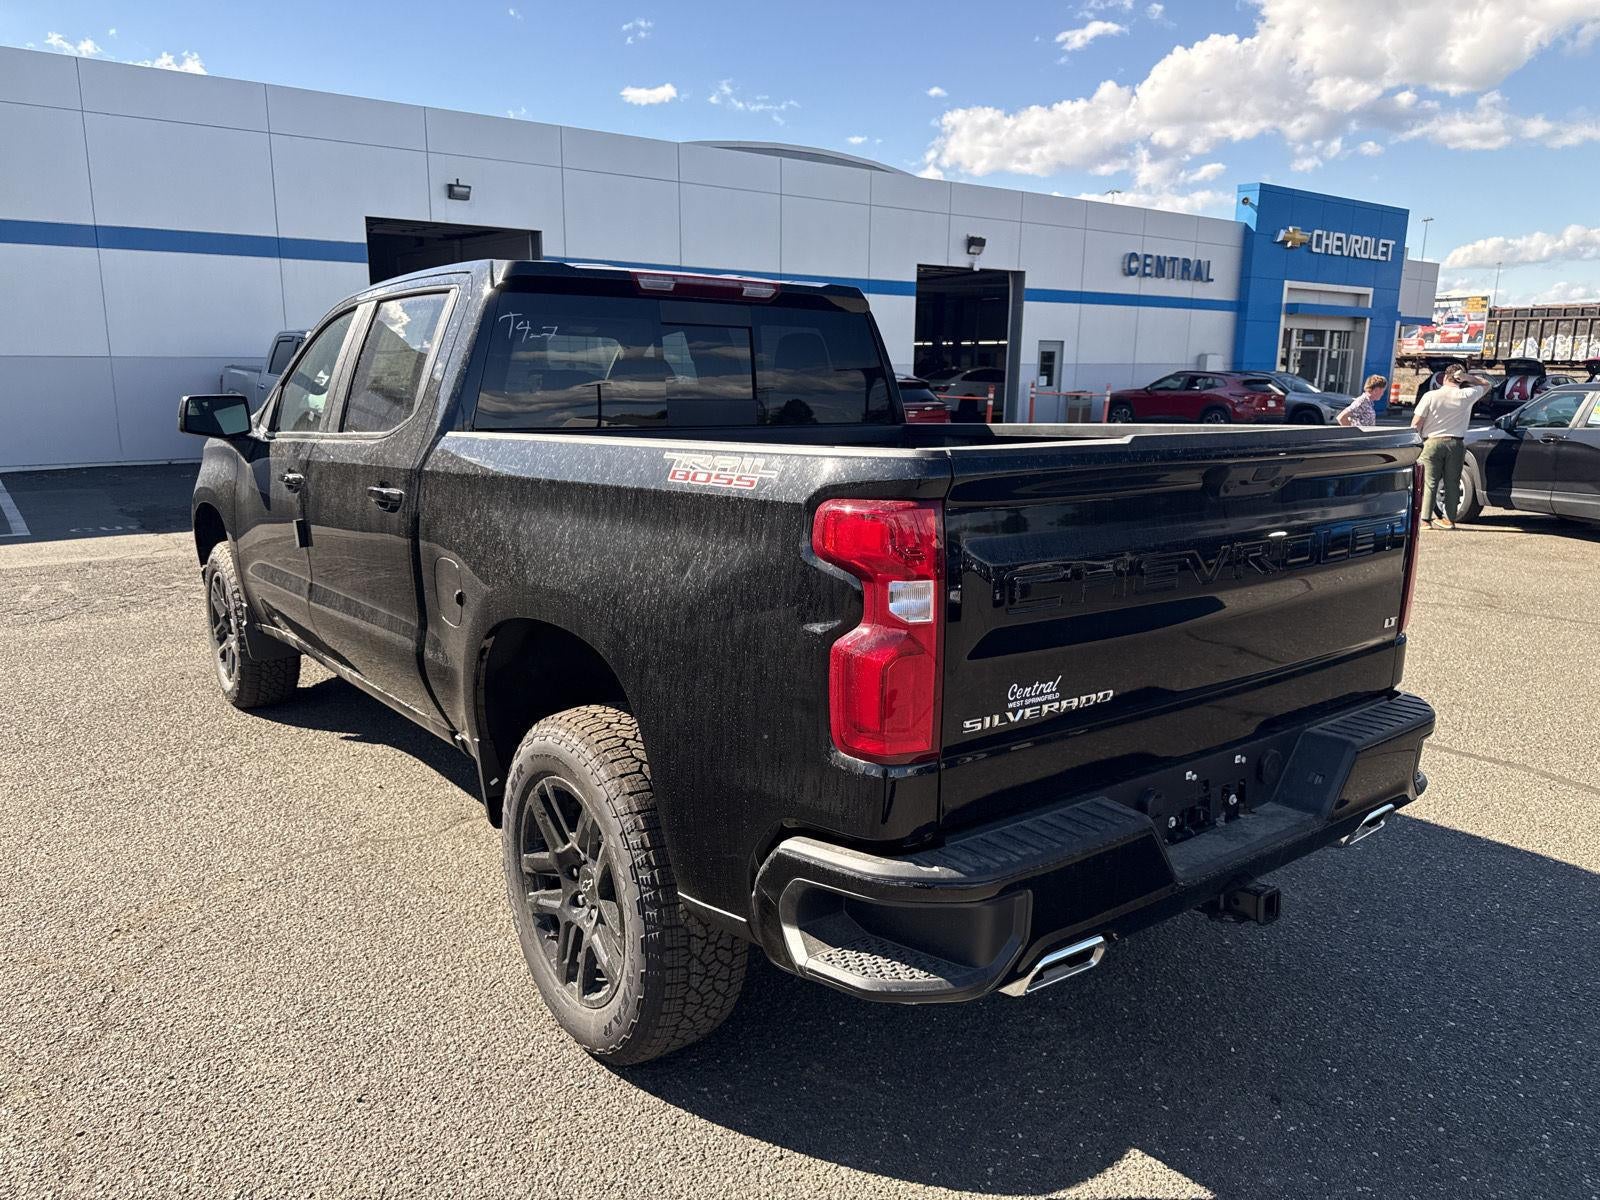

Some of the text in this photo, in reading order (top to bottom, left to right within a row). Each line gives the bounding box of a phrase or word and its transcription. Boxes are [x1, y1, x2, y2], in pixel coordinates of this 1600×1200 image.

[1311, 229, 1396, 262] CHEVROLET
[1122, 251, 1214, 283] CENTRAL
[663, 452, 779, 479] TRAIL
[667, 468, 760, 490] BOSS
[1004, 514, 1407, 617] CHEVROLET
[1383, 616, 1398, 629] LT
[1007, 674, 1062, 701] Central
[1007, 692, 1061, 709] WEST SPRINGFIELD
[962, 689, 1114, 734] SILVERADO
